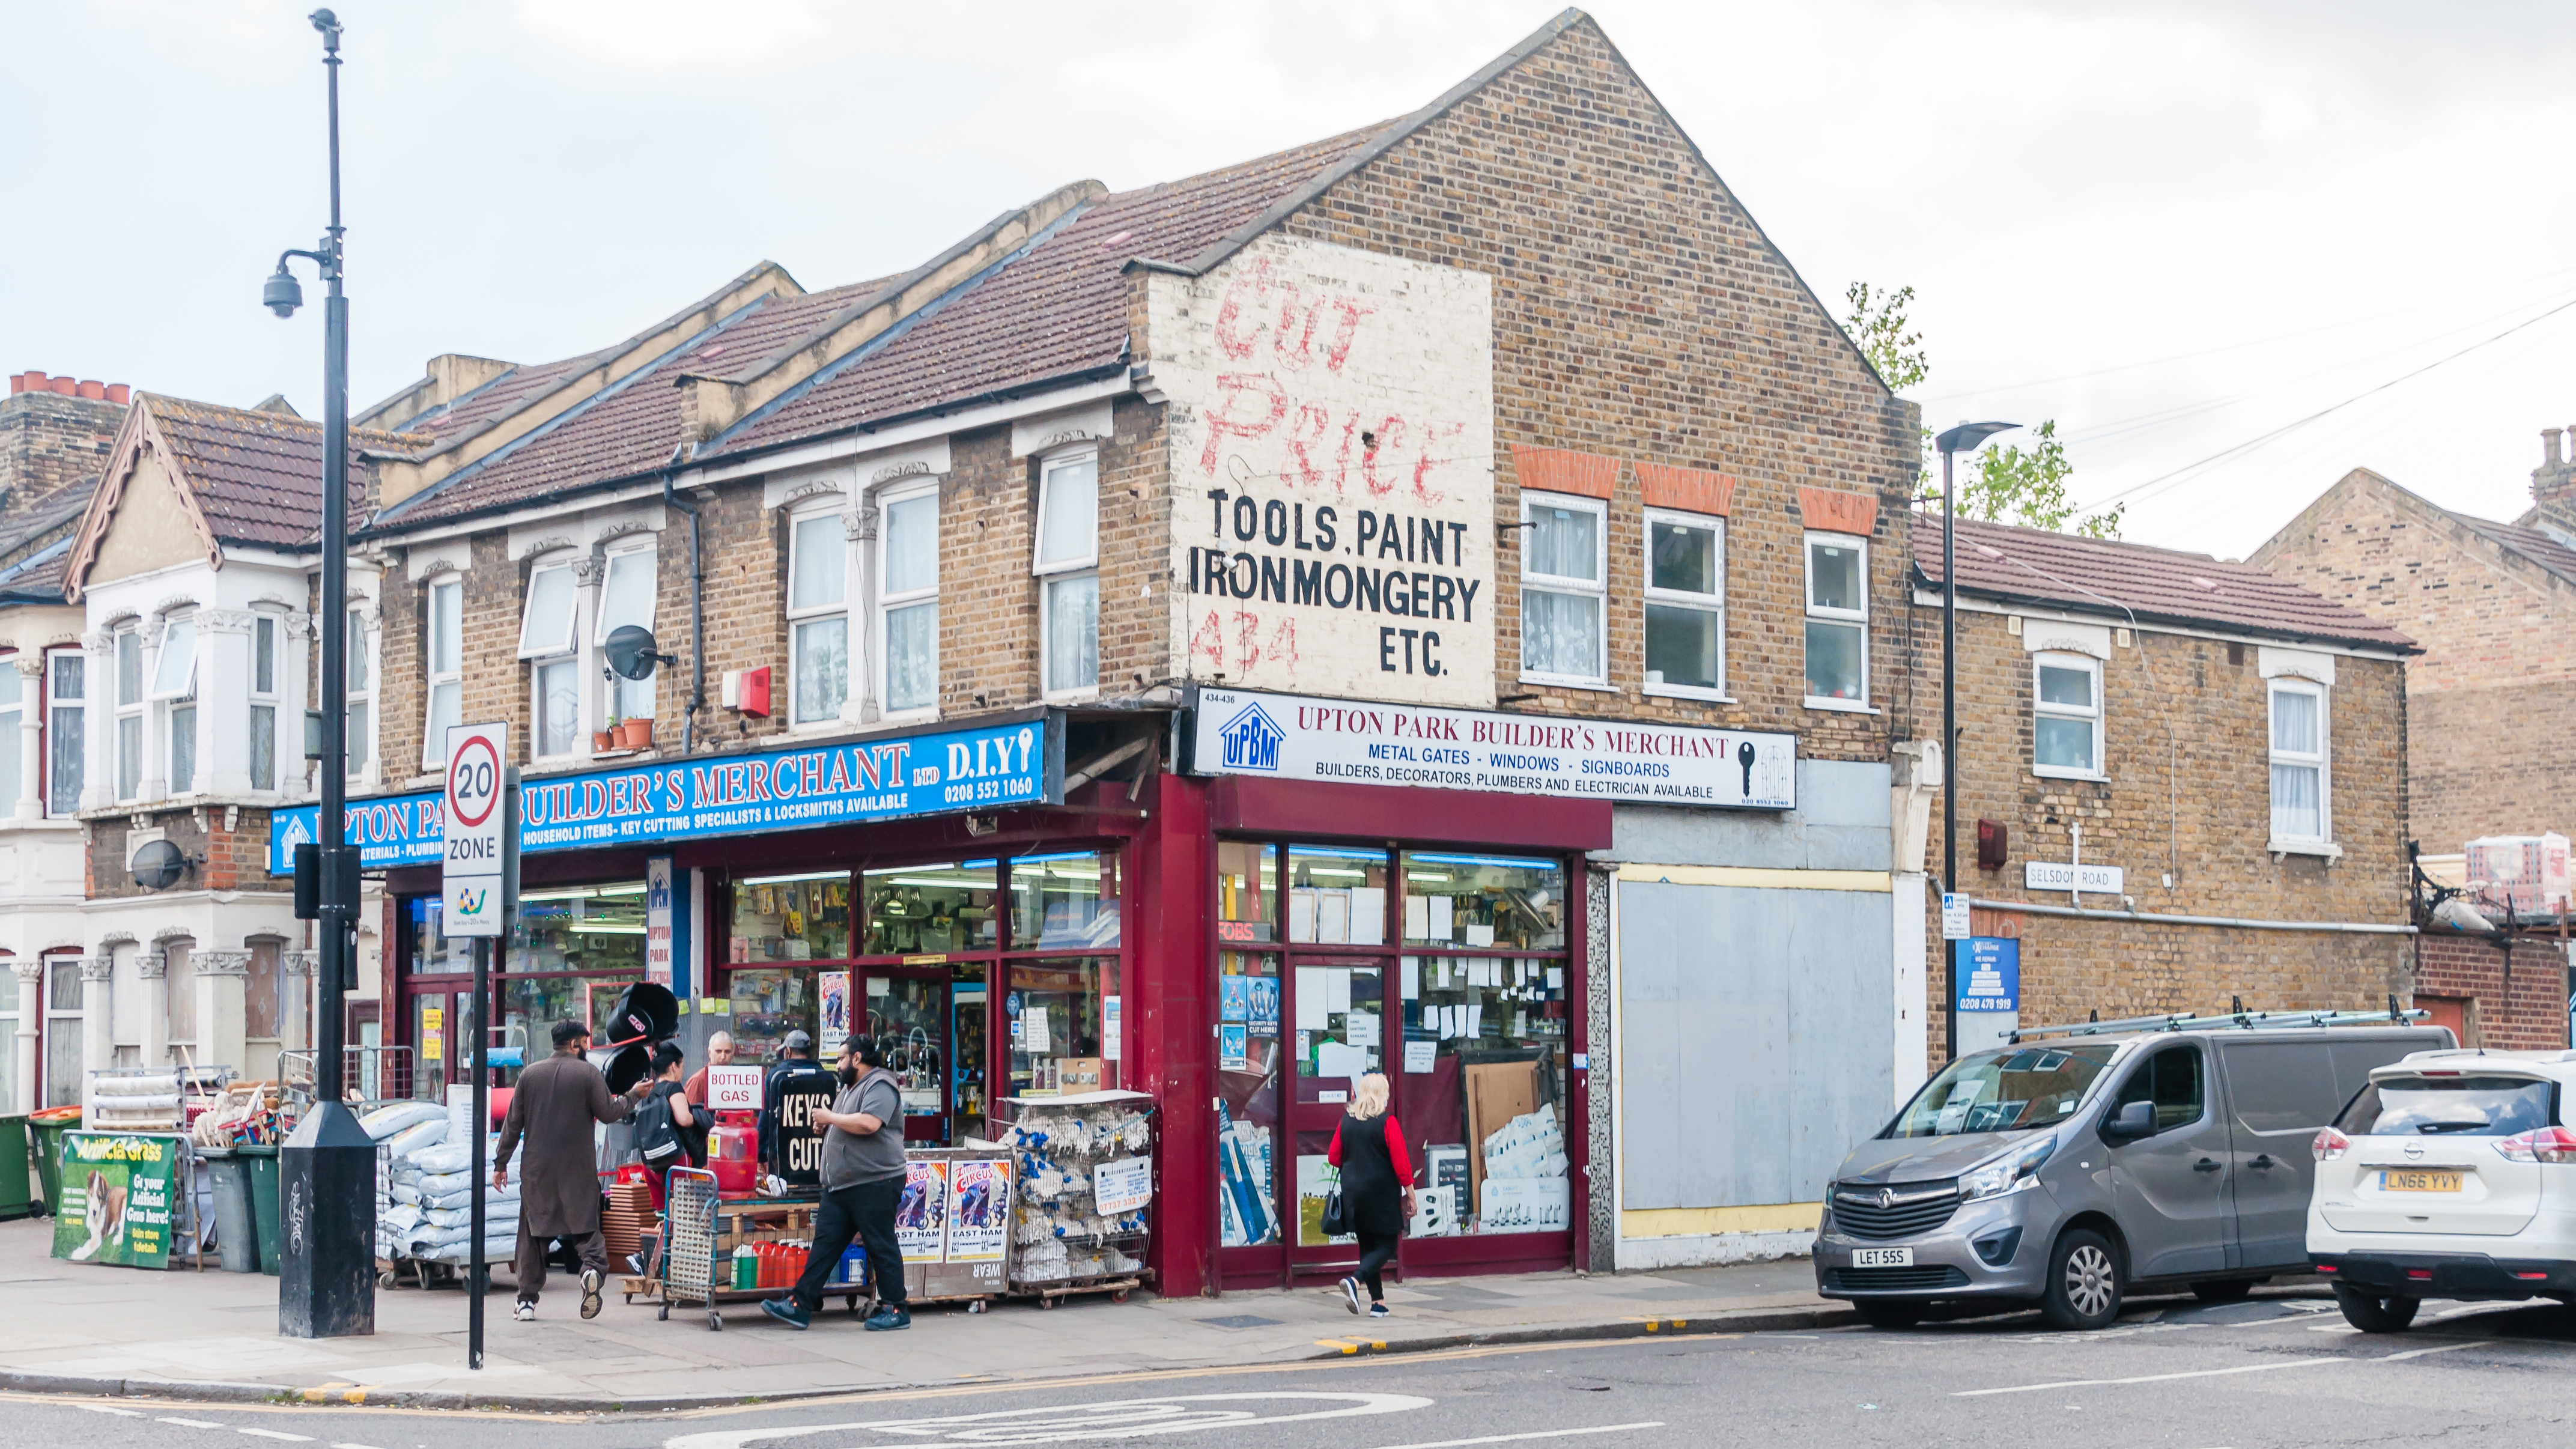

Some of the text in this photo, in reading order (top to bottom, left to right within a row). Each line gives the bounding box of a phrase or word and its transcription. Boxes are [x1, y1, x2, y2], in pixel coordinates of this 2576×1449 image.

[1214, 256, 1379, 377] CUT
[1200, 371, 1466, 509] PRICE
[1358, 510, 1468, 567] PAINT
[1190, 546, 1481, 623] IRONMONGERY
[1380, 626, 1449, 677] ETC.
[1205, 693, 1236, 704] 434-436
[1226, 716, 1278, 767] UPBM
[1298, 706, 1730, 759] UPTON PARK BUILDER'S MERCHANT
[1368, 743, 1417, 762] METAL
[1422, 747, 1470, 765] GATES
[1490, 752, 1560, 772] WINDOWS
[1582, 759, 1670, 778] SIGNBOARDS
[416, 798, 445, 838] PA
[692, 742, 911, 809] MERCHANT
[913, 765, 940, 788] LTD
[946, 735, 1016, 781] D.I.Y
[458, 762, 493, 799] 20
[944, 776, 1033, 803] 0208 552 1060
[1316, 762, 1713, 799] BUILDERS, DECORATORS, PLUMBERS AND ELECTRICIAN AVAILABLE
[360, 844, 399, 861] ATERIALS
[406, 841, 444, 857] PLUMBIN
[523, 825, 581, 845] HOUSEHOLD
[621, 820, 641, 836] KEY
[643, 815, 690, 833] CUTTING
[694, 808, 762, 829] SPECIALISTS
[764, 806, 772, 822] &
[774, 797, 844, 821] LOCKSMITHS
[846, 792, 908, 813] AVAILABLE
[449, 836, 495, 860] ZONE
[2082, 872, 2109, 886] ROAD
[648, 926, 670, 940] UPTON
[1218, 922, 1254, 941] FOBS
[649, 948, 669, 962] PARK
[822, 979, 844, 1000] CIRCUS
[1960, 998, 2011, 1009] 0208 478 1919
[711, 1074, 759, 1086] BOTTLED
[721, 1090, 749, 1102] GAS
[783, 1093, 831, 1128] KEY'S
[127, 1140, 162, 1162] Grass
[789, 1137, 822, 1171] CUT
[143, 1176, 165, 1192] your
[906, 1168, 930, 1185] RCUS
[956, 1168, 994, 1193] CIRCUS
[2389, 1174, 2459, 1188] LN66 YVY
[1099, 1200, 1120, 1212] 07737
[1123, 1197, 1136, 1206] 332
[145, 1208, 169, 1225] here!
[1860, 1250, 1904, 1264] LET 55S
[973, 1263, 1001, 1278] WEAR
